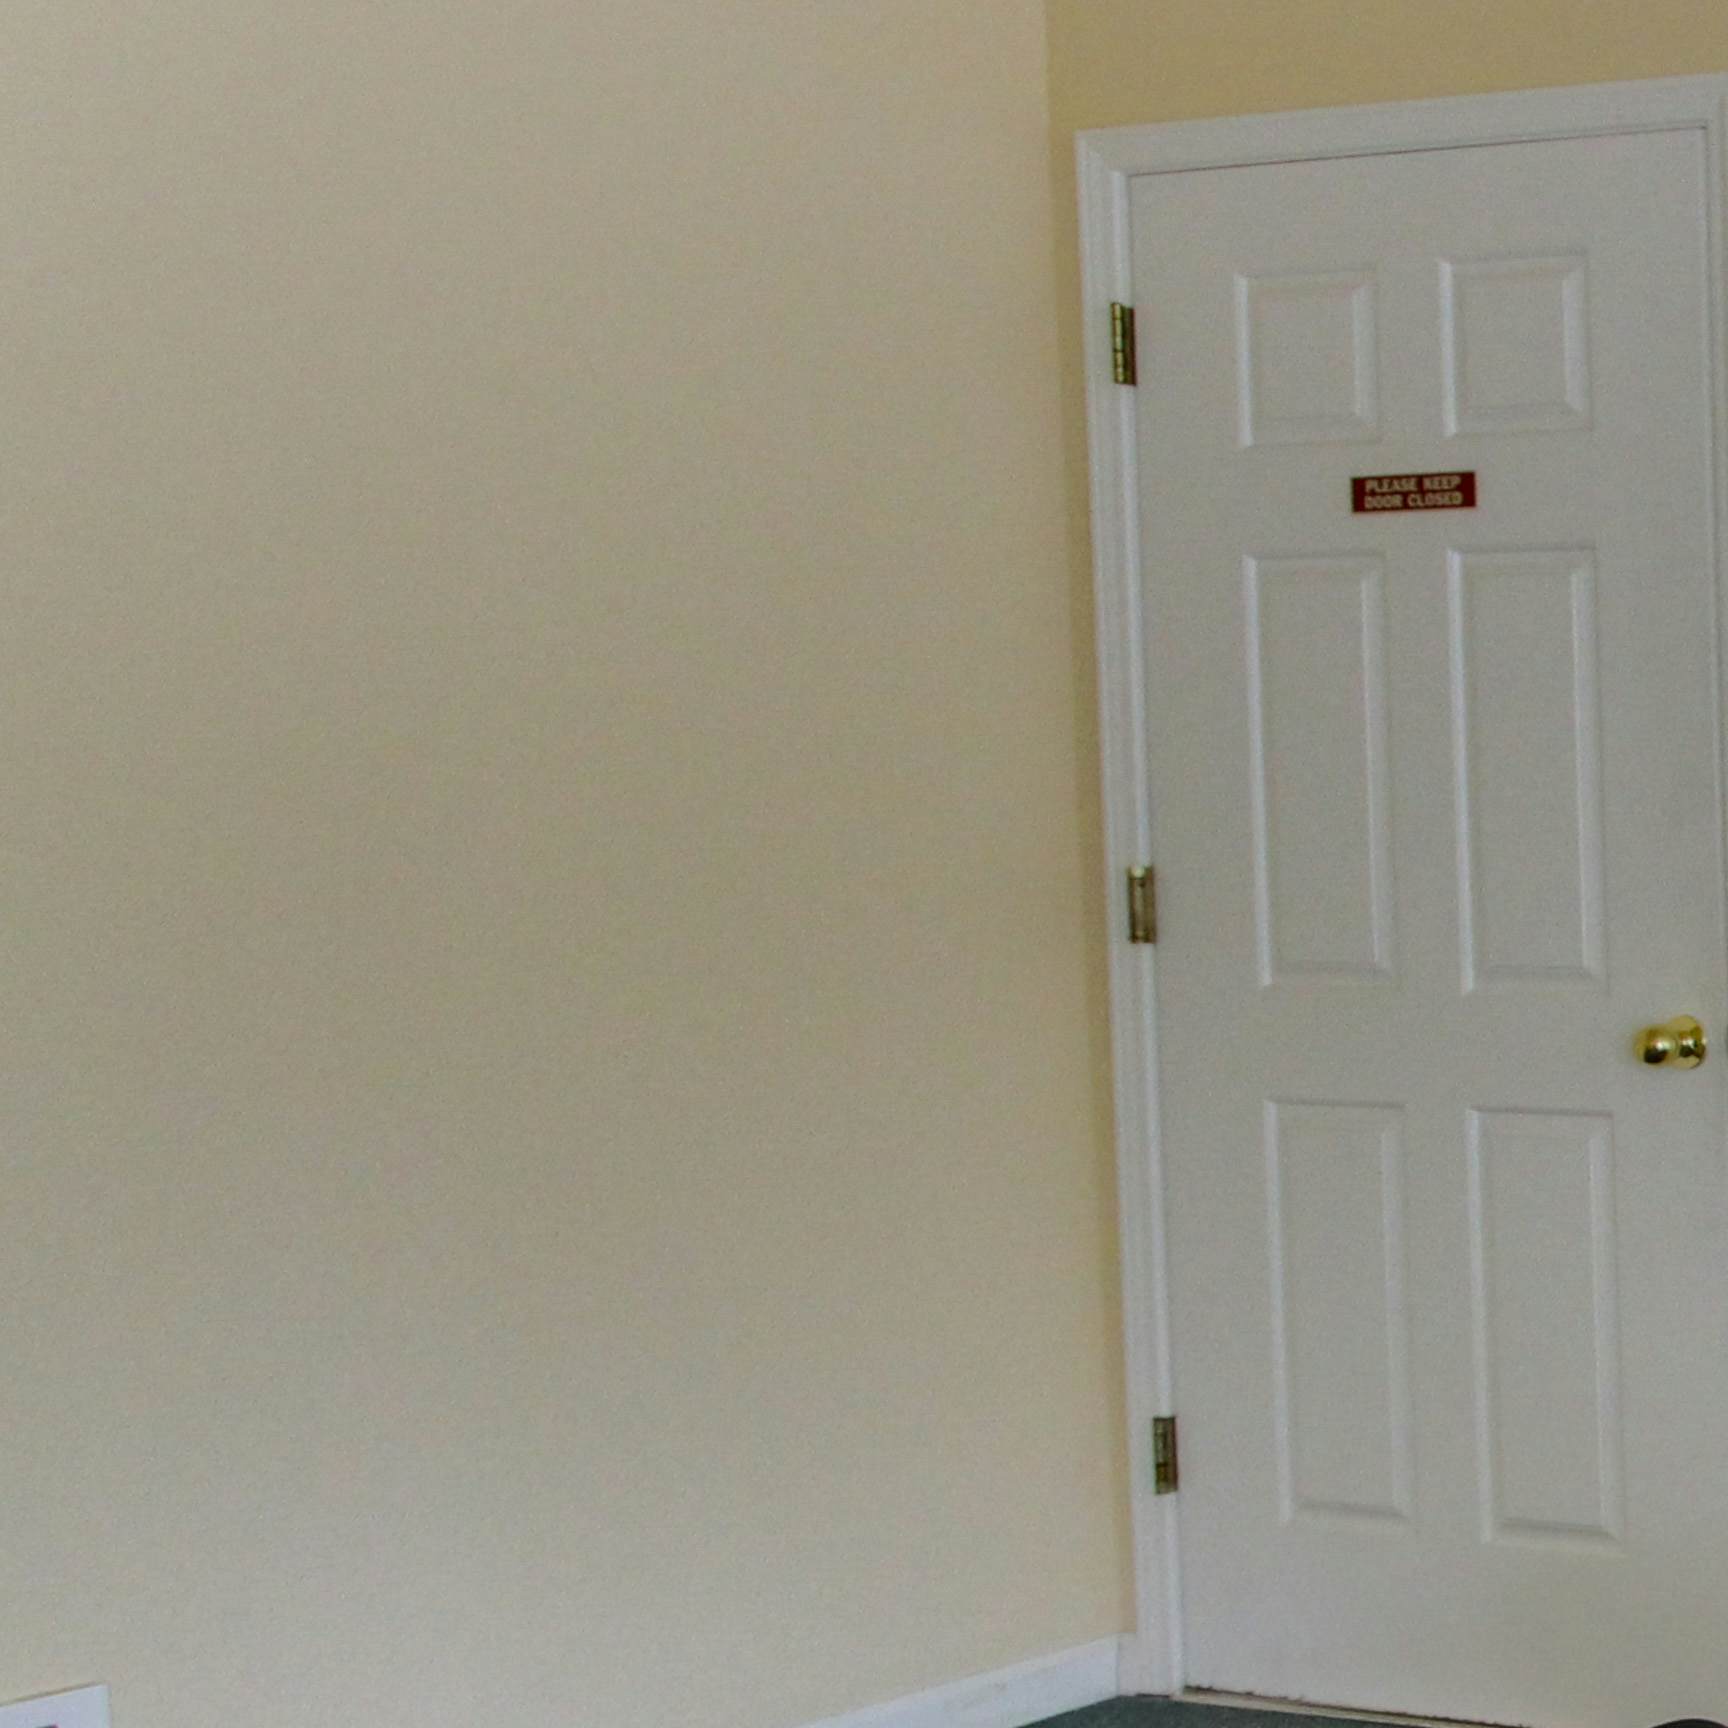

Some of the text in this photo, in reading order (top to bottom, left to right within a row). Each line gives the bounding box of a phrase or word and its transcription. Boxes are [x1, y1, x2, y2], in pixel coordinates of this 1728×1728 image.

[1364, 475, 1461, 493] PLEASE KEEP
[1363, 491, 1463, 509] DOOR CLOSED
